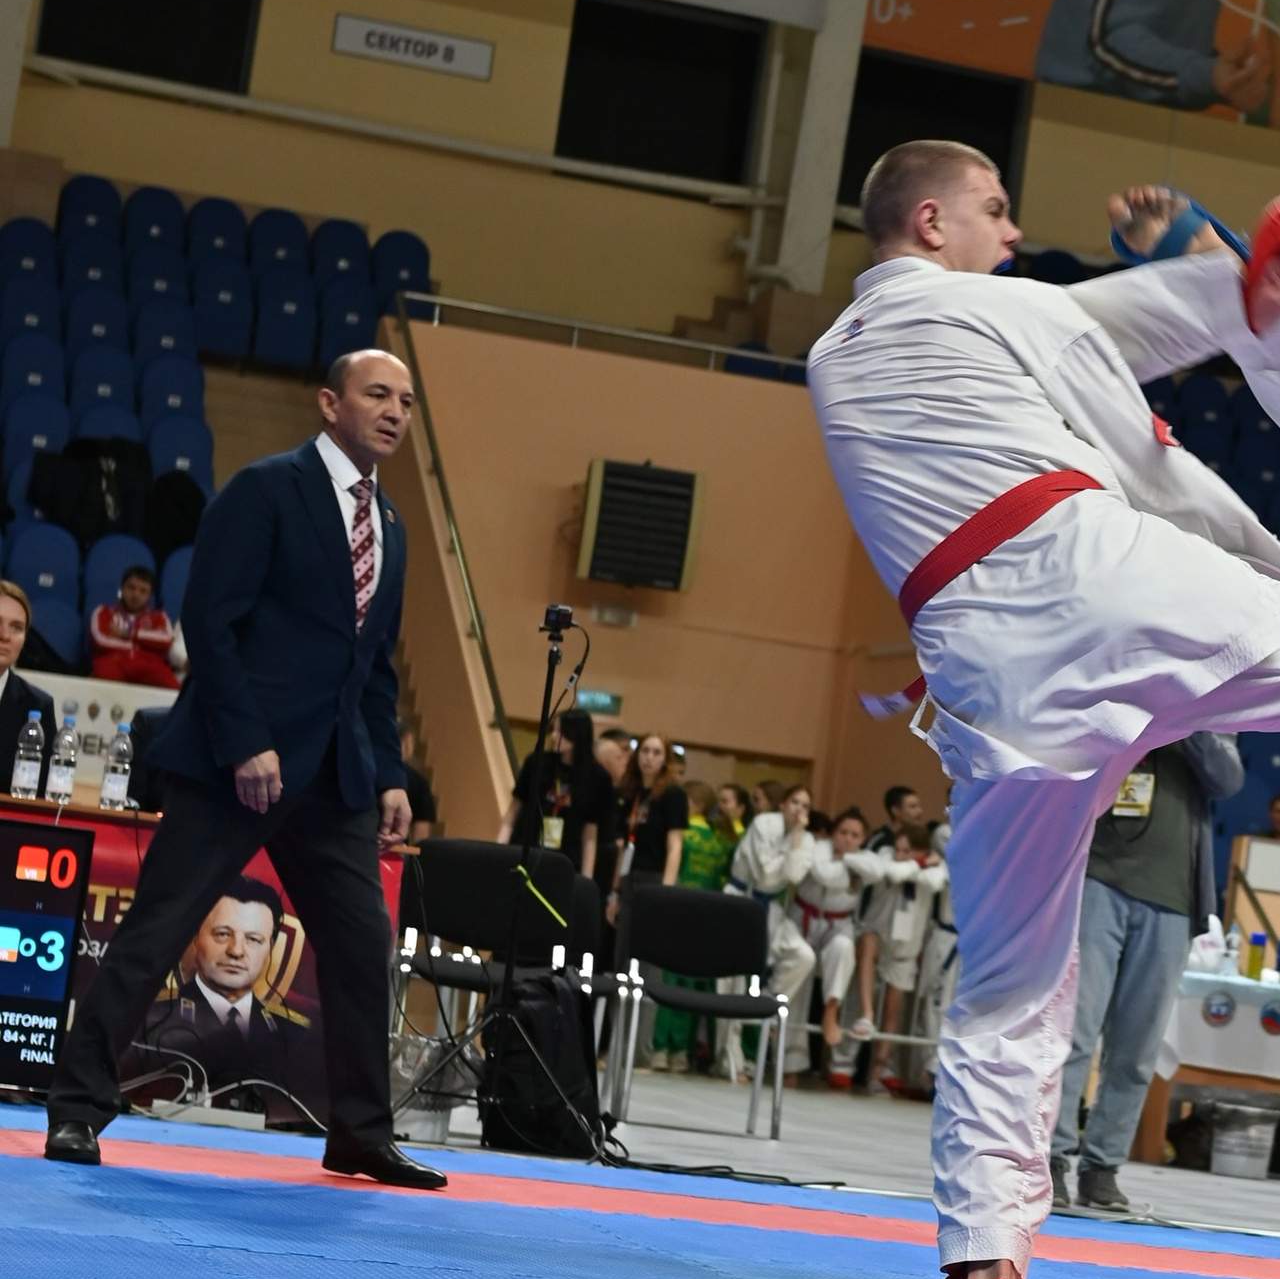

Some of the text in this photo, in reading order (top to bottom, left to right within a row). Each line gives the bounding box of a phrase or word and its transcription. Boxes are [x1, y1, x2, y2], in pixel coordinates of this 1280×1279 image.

[364, 29, 439, 59] СЕКТОР
[50, 848, 78, 889] 0
[36, 930, 65, 972] 3
[3, 1029, 27, 1043] 84+
[20, 1048, 56, 1065] FINAL
